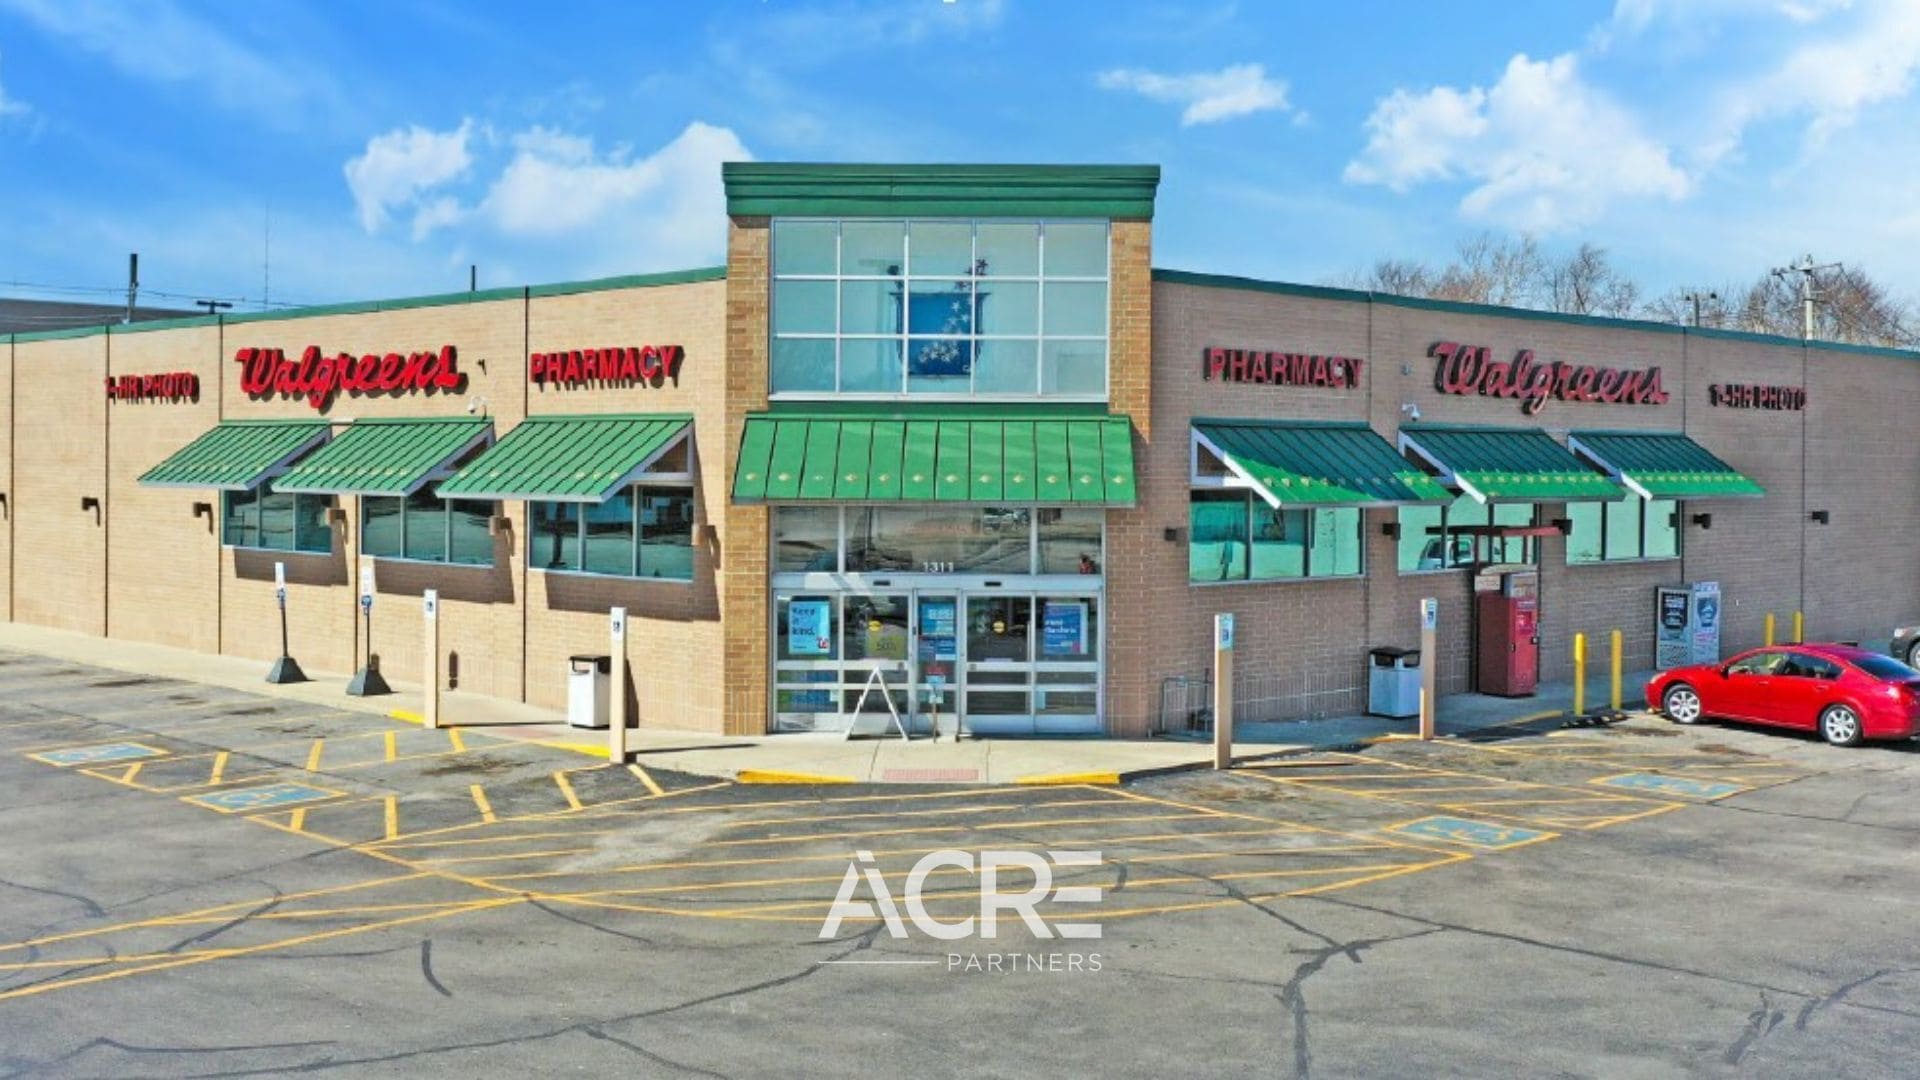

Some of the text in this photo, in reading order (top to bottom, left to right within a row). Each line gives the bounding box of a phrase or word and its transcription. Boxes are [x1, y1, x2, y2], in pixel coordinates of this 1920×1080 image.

[235, 345, 461, 409] Walgreens
[531, 345, 677, 383] PHARMACY
[1206, 347, 1364, 389] PHARMACY
[1431, 342, 1670, 414] Walgreens
[142, 372, 194, 398] PHOTO
[1759, 385, 1806, 410] PHOTO
[923, 562, 954, 573] 1311
